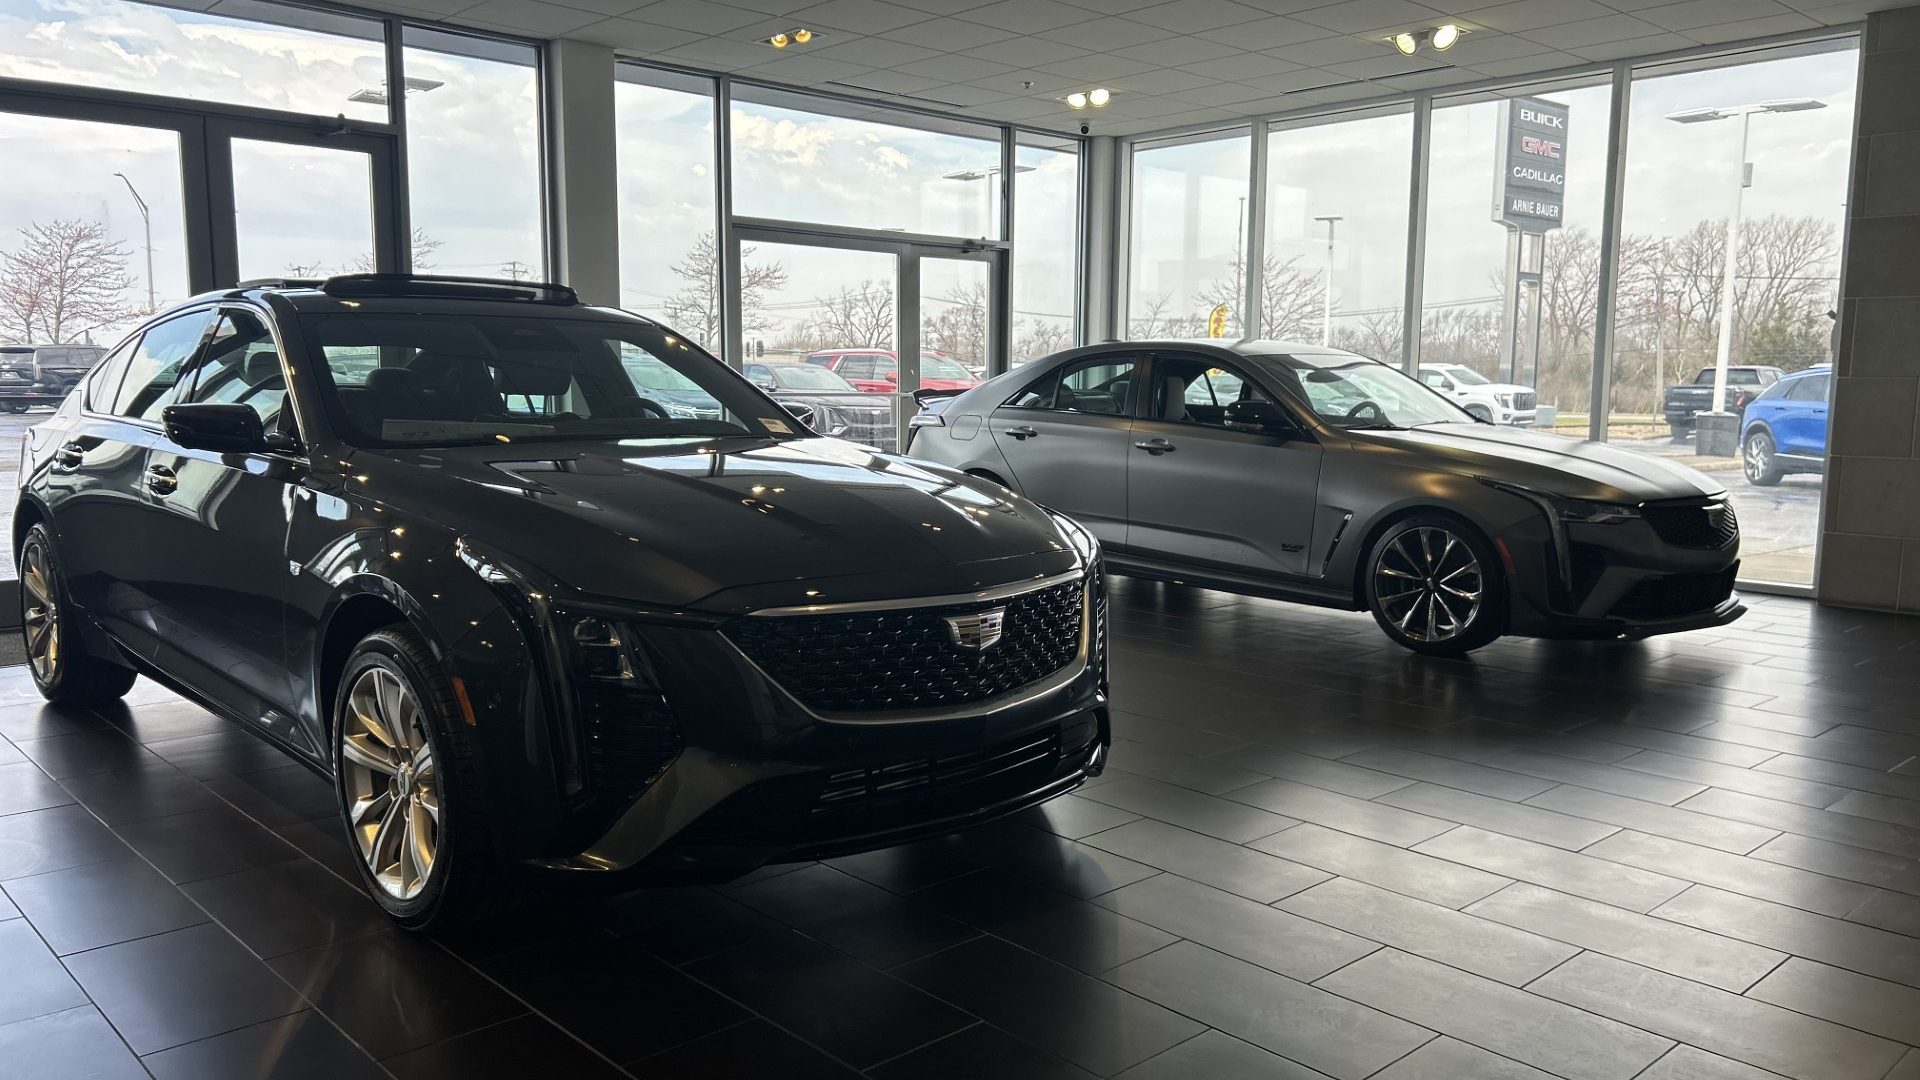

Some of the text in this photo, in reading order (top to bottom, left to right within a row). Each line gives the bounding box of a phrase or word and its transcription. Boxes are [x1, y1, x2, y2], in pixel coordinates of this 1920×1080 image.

[1520, 108, 1563, 129] BUICK
[1521, 136, 1560, 159] GMC
[1513, 166, 1563, 185] CADILLAC
[1512, 199, 1559, 217] ARNIE BAUER
